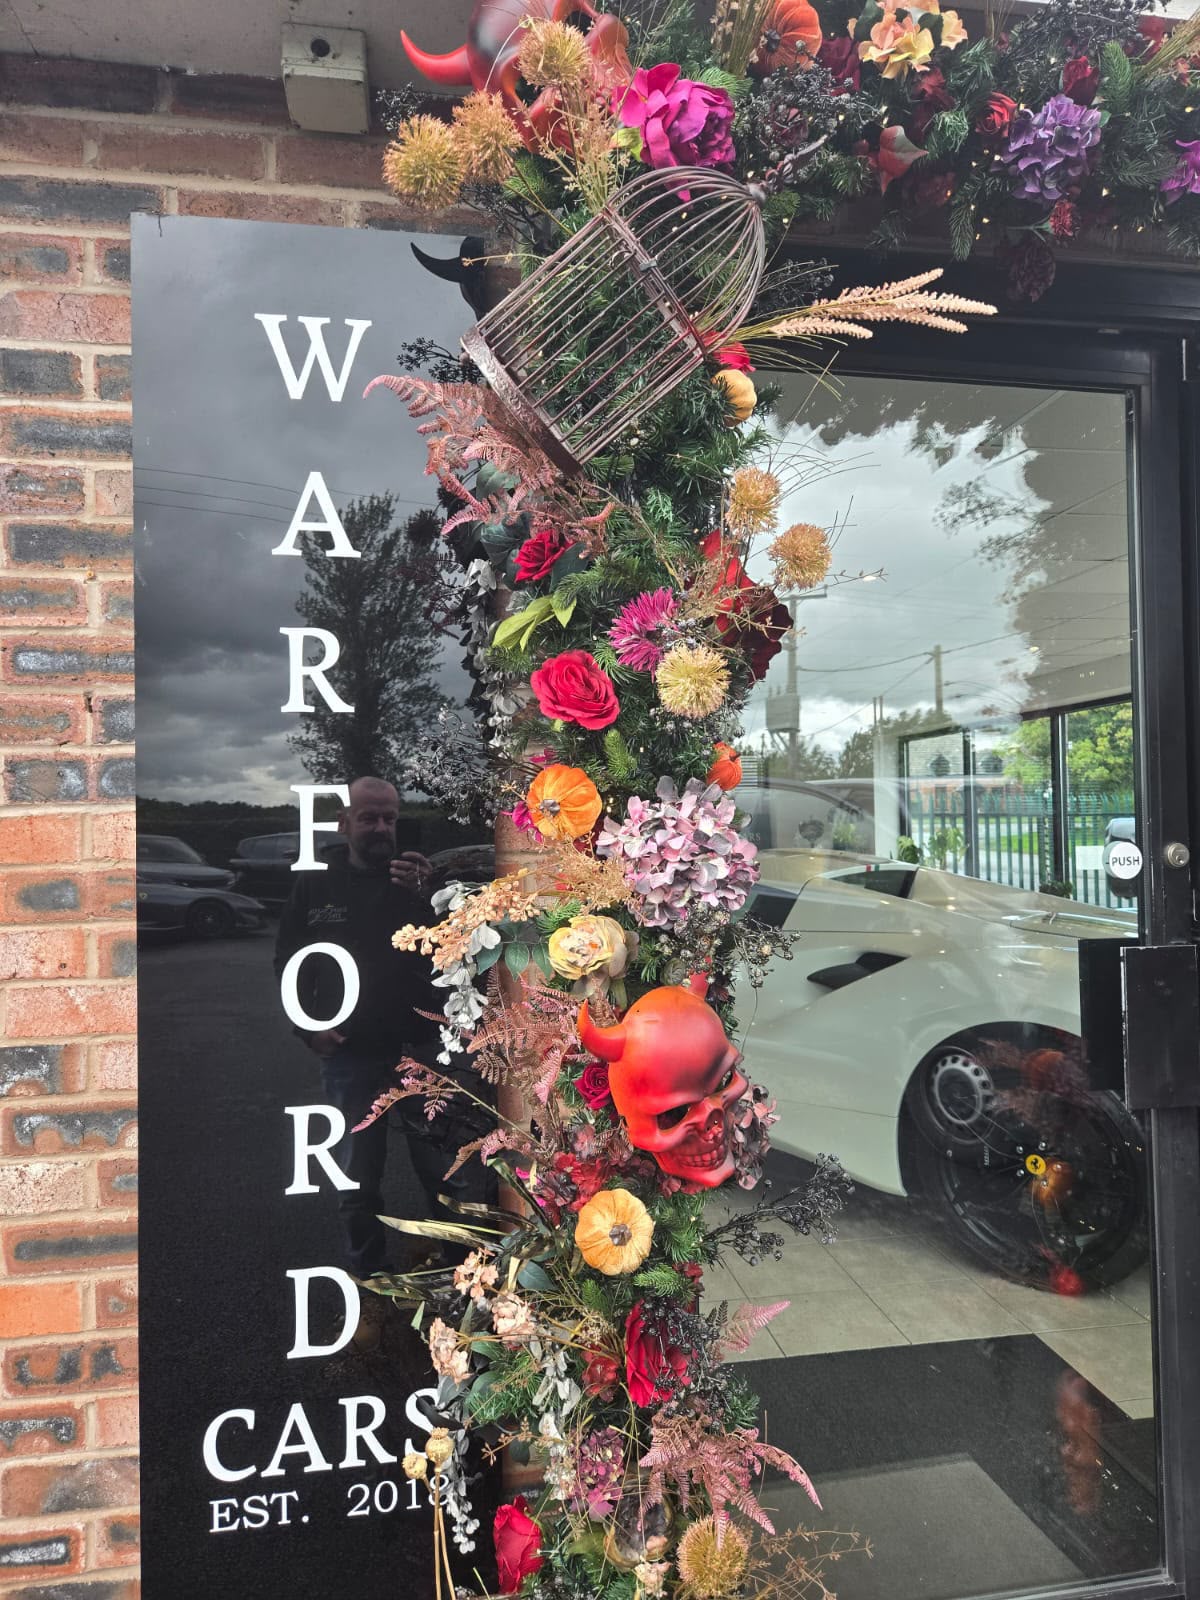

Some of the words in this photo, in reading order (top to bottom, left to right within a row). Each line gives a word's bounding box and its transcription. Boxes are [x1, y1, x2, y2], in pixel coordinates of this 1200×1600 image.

[254, 312, 373, 1361] WARFORD
[1112, 856, 1140, 866] PUSH
[202, 1387, 442, 1482] CARS
[208, 1491, 309, 1533] EST.
[346, 1474, 449, 1517] 2018
